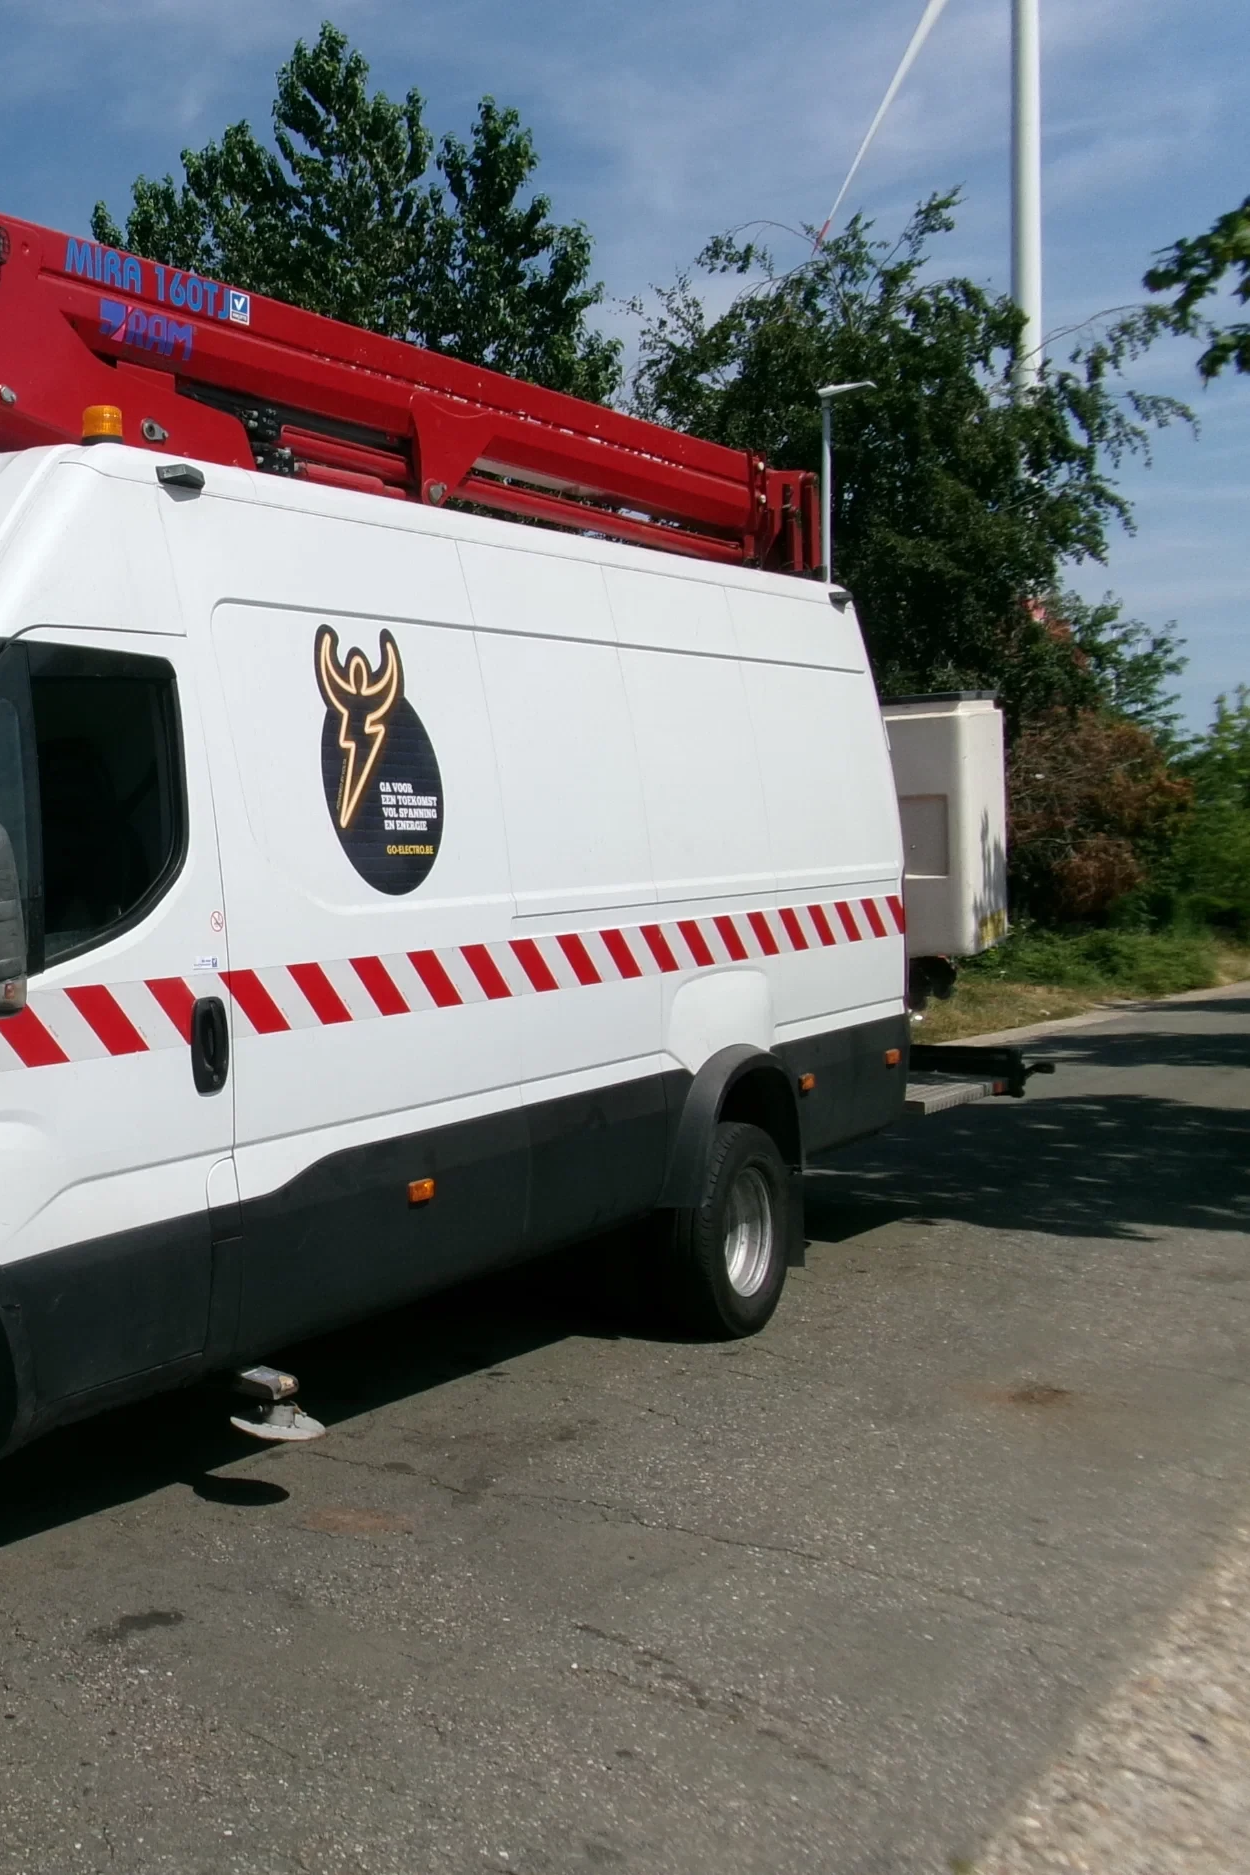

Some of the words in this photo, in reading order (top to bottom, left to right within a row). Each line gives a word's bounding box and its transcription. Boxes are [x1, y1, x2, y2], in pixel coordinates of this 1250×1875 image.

[65, 238, 142, 294] MIRA
[154, 266, 230, 320] 160TJ
[379, 781, 392, 792] GA
[392, 782, 413, 793] VOOR
[381, 794, 396, 805] EEN
[397, 795, 437, 806] TOEKOMST
[382, 807, 398, 818] VOL
[398, 807, 437, 819] SPANNING
[384, 819, 395, 830] EN
[396, 820, 428, 831] ENERGIE
[386, 845, 434, 855] GO-ELECTRO.BE
